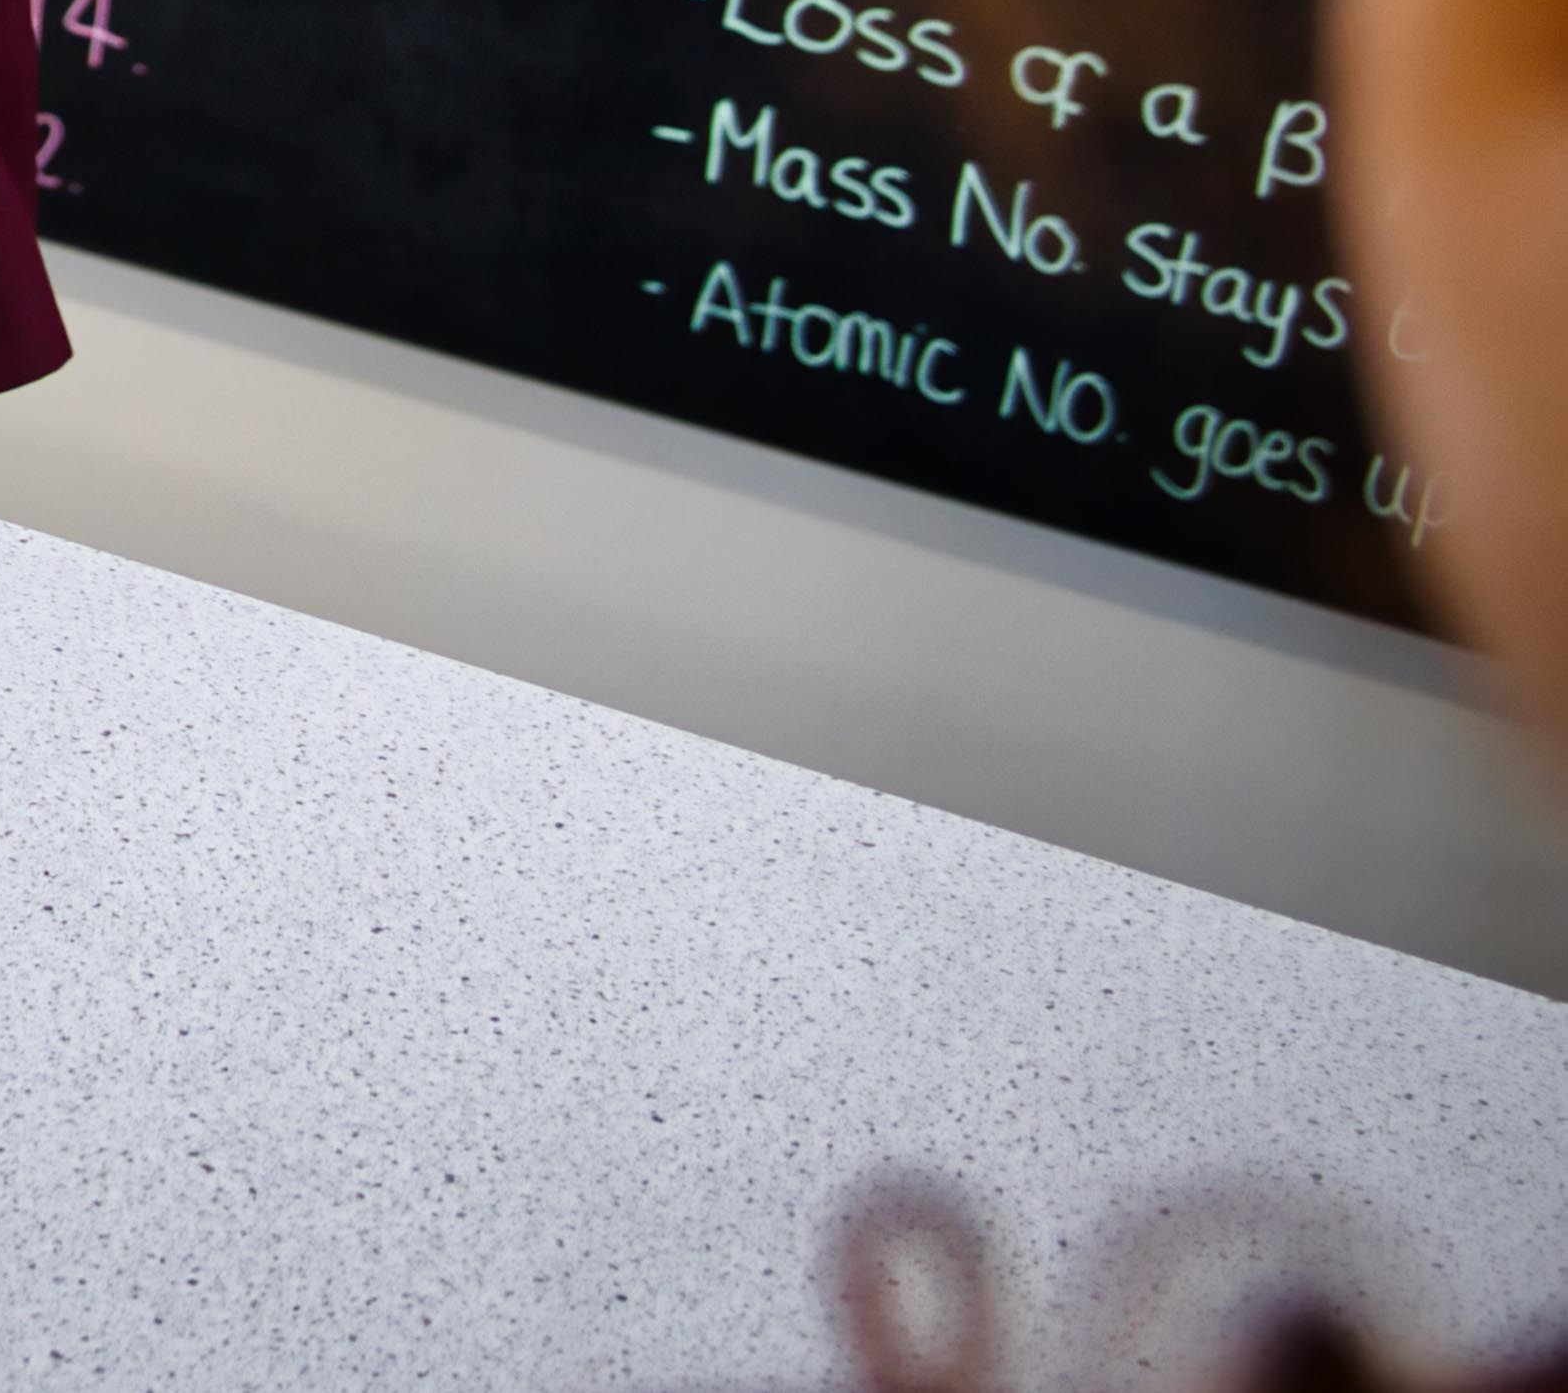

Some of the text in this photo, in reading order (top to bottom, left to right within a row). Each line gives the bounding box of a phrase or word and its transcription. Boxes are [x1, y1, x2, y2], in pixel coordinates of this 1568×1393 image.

[1011, 39, 1108, 130] of
[1140, 83, 1206, 144] a
[951, 160, 1088, 278] No.
[1148, 402, 1334, 503] goes
